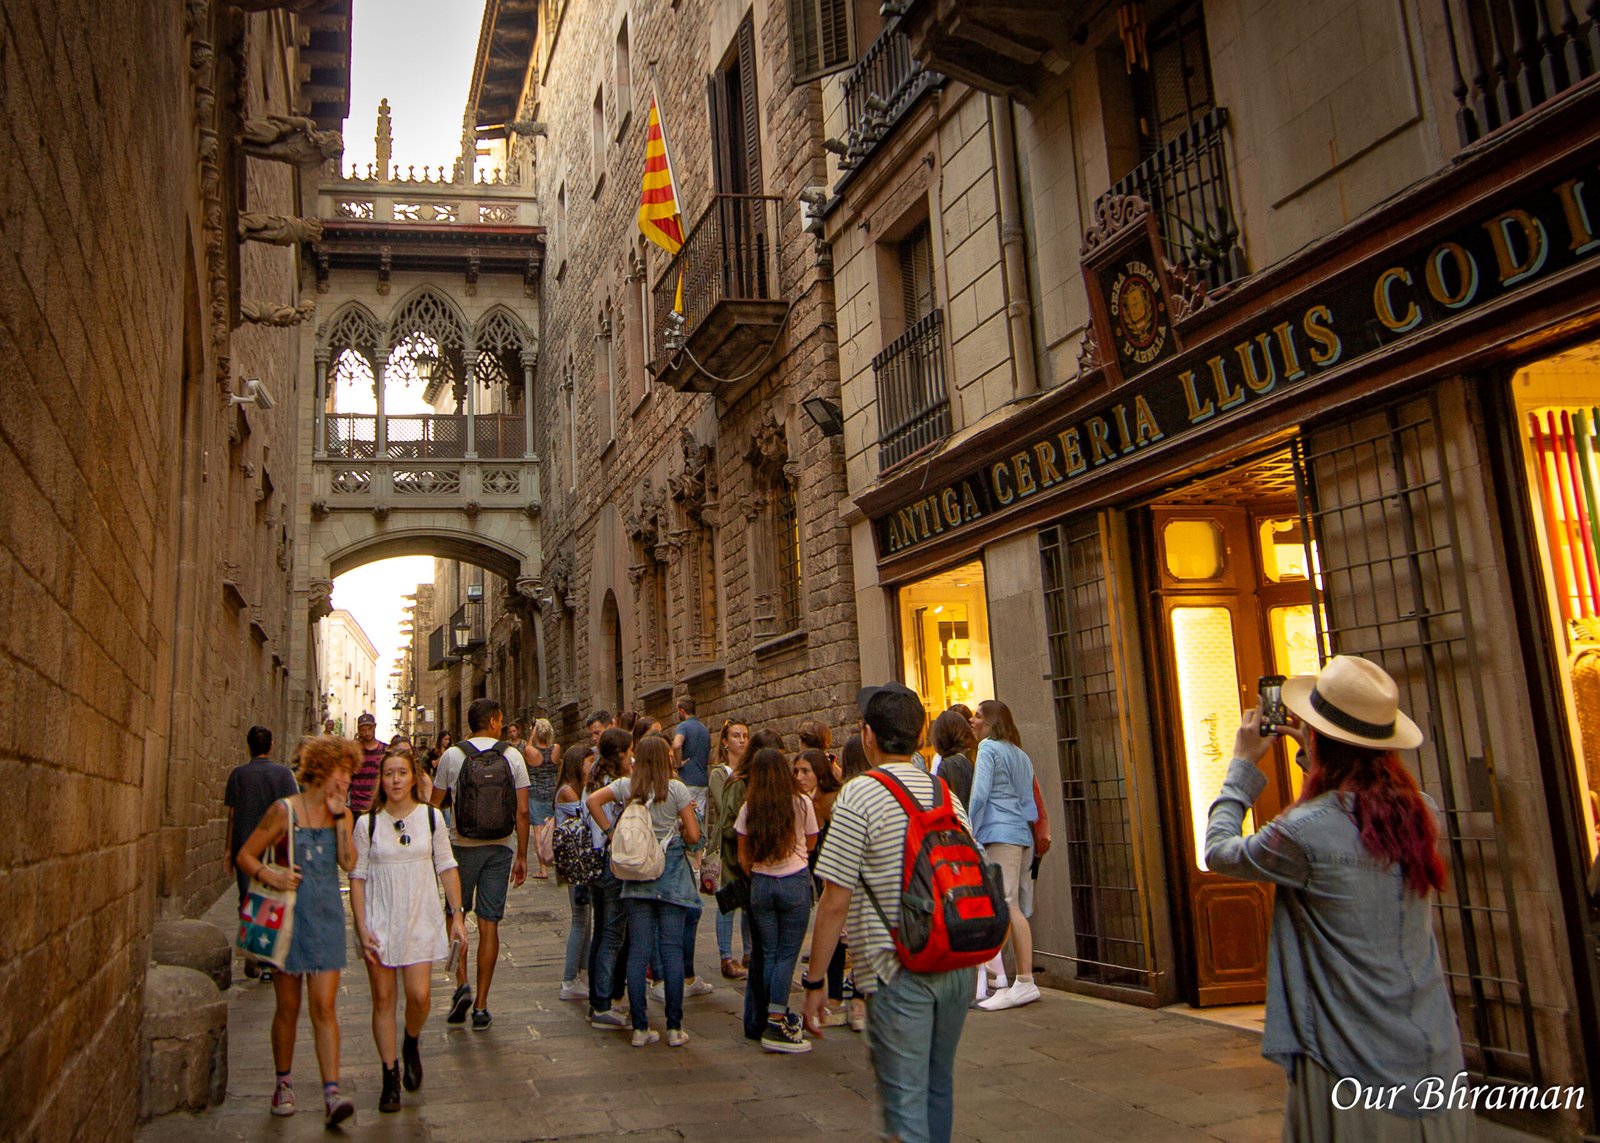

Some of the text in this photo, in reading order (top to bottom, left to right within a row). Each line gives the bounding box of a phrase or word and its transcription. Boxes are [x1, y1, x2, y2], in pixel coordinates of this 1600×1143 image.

[1112, 262, 1160, 315] CERA VERGE
[1124, 327, 1166, 363] D'ABELLA
[888, 481, 981, 551] ANTIGA
[992, 394, 1165, 505] CERERIA
[1178, 305, 1343, 424] LLUIS
